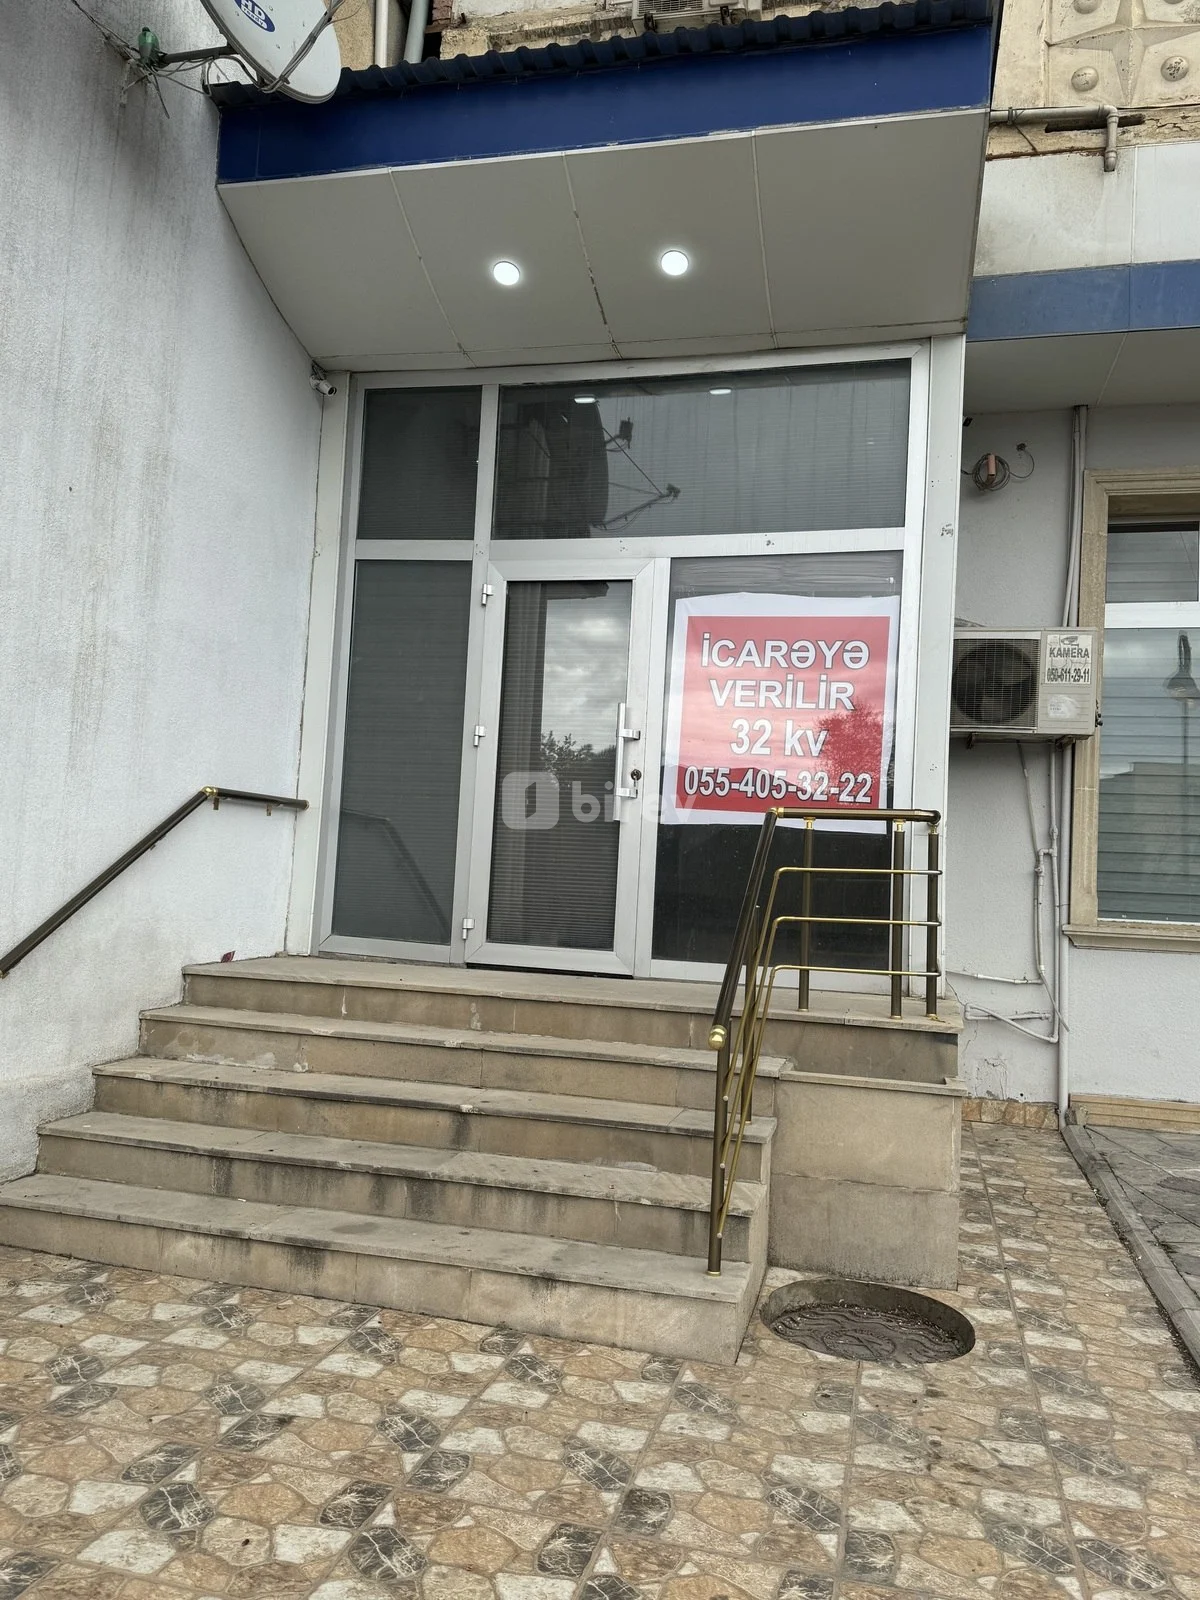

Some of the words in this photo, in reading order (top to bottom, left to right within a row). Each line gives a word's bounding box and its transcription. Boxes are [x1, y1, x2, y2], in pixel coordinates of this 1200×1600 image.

[701, 632, 870, 670] İCARƏYƏ
[1049, 647, 1090, 659] KAMERA
[709, 673, 855, 710] VERİLİR
[730, 718, 772, 756] 32
[783, 719, 829, 757] kv
[684, 765, 872, 804] 055-405-32-22
